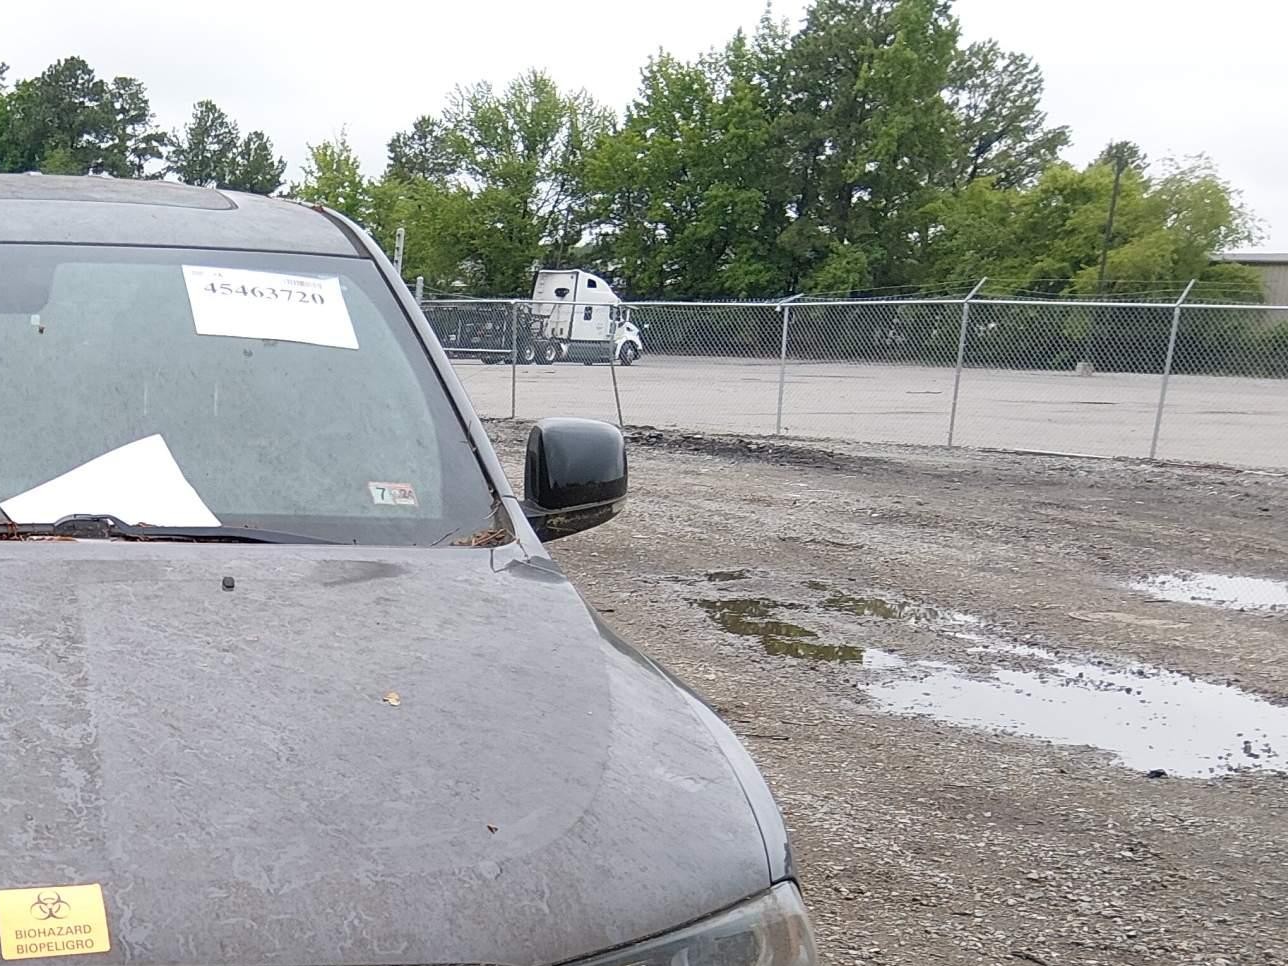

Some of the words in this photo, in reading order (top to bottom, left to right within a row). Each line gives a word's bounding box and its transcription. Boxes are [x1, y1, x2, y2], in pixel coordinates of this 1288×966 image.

[203, 281, 326, 305] 45463720
[375, 486, 386, 501] 7
[14, 924, 93, 940] BIOHAZARD
[16, 938, 95, 955] BIOPELIGRO
